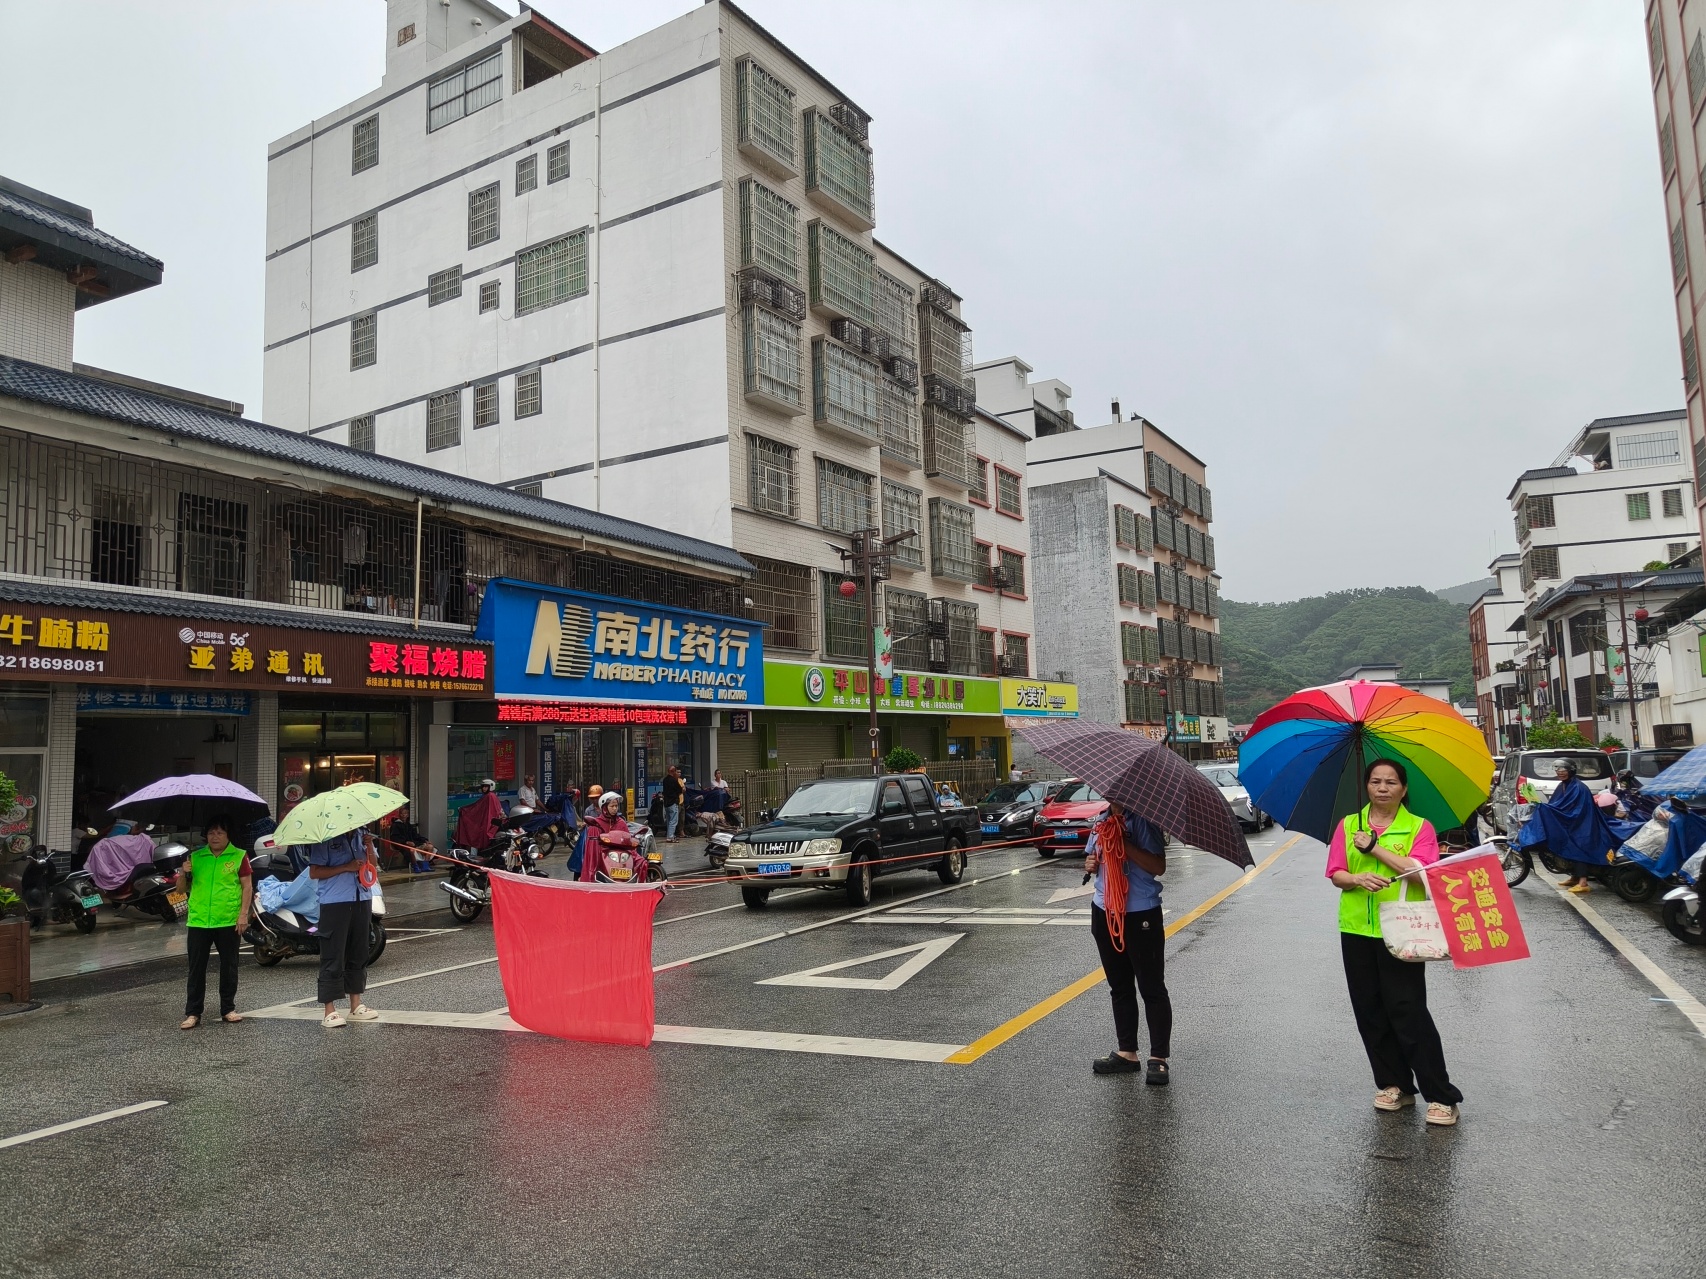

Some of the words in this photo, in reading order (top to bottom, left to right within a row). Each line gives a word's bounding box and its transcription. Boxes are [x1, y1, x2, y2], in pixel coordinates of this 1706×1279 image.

[197, 631, 224, 640] 中国移动
[594, 611, 750, 667] 南北药行
[188, 645, 325, 676] 亚弟通讯
[369, 641, 487, 679] 聚福烧腊
[657, 667, 746, 688] PHARMACY
[692, 687, 714, 699] 平山店
[733, 713, 746, 730] 药
[1441, 874, 1483, 953] 人人有责
[1467, 867, 1510, 948] 交通安全
